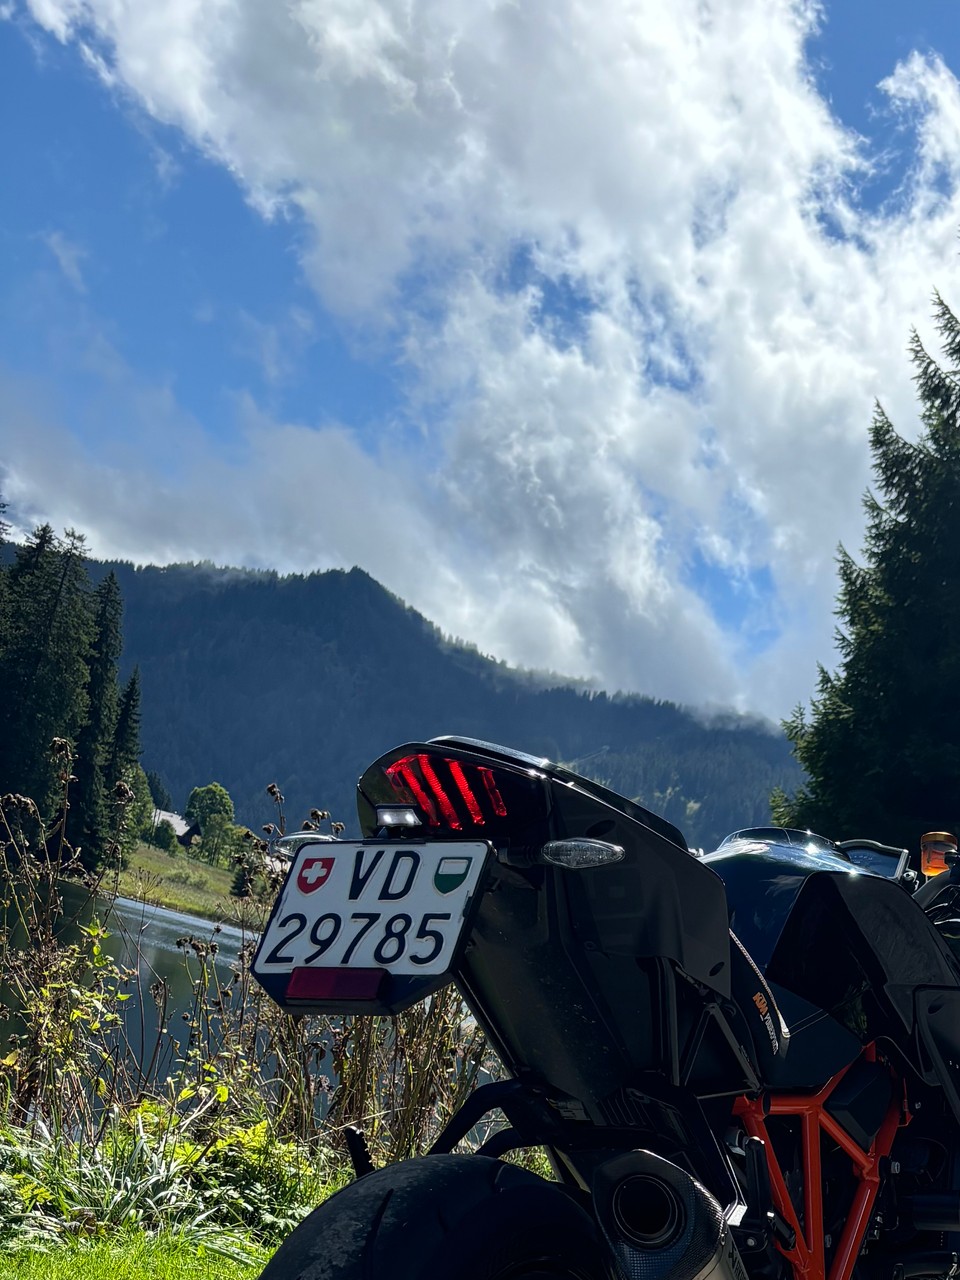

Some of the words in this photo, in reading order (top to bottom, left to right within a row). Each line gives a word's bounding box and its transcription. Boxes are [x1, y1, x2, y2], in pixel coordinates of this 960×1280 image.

[348, 850, 421, 901] VD
[264, 912, 452, 966] 29785
[752, 991, 769, 1017] KTM
